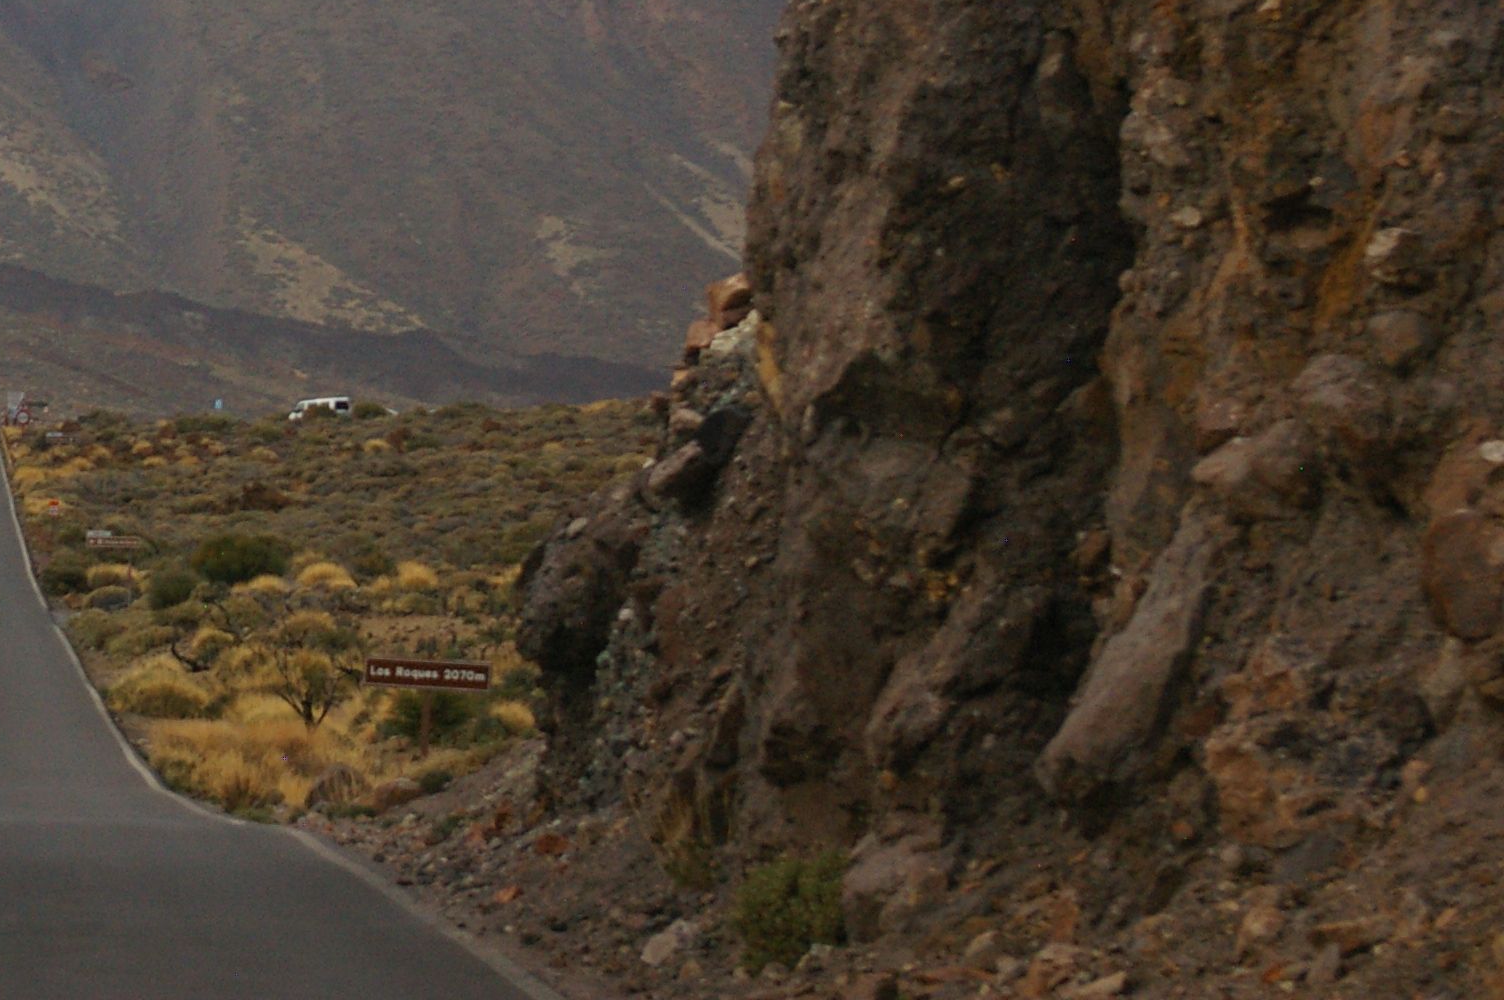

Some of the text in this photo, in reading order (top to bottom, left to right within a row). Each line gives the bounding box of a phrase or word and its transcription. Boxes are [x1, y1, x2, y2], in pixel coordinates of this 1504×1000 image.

[369, 665, 485, 681] Los Roques 2070m
